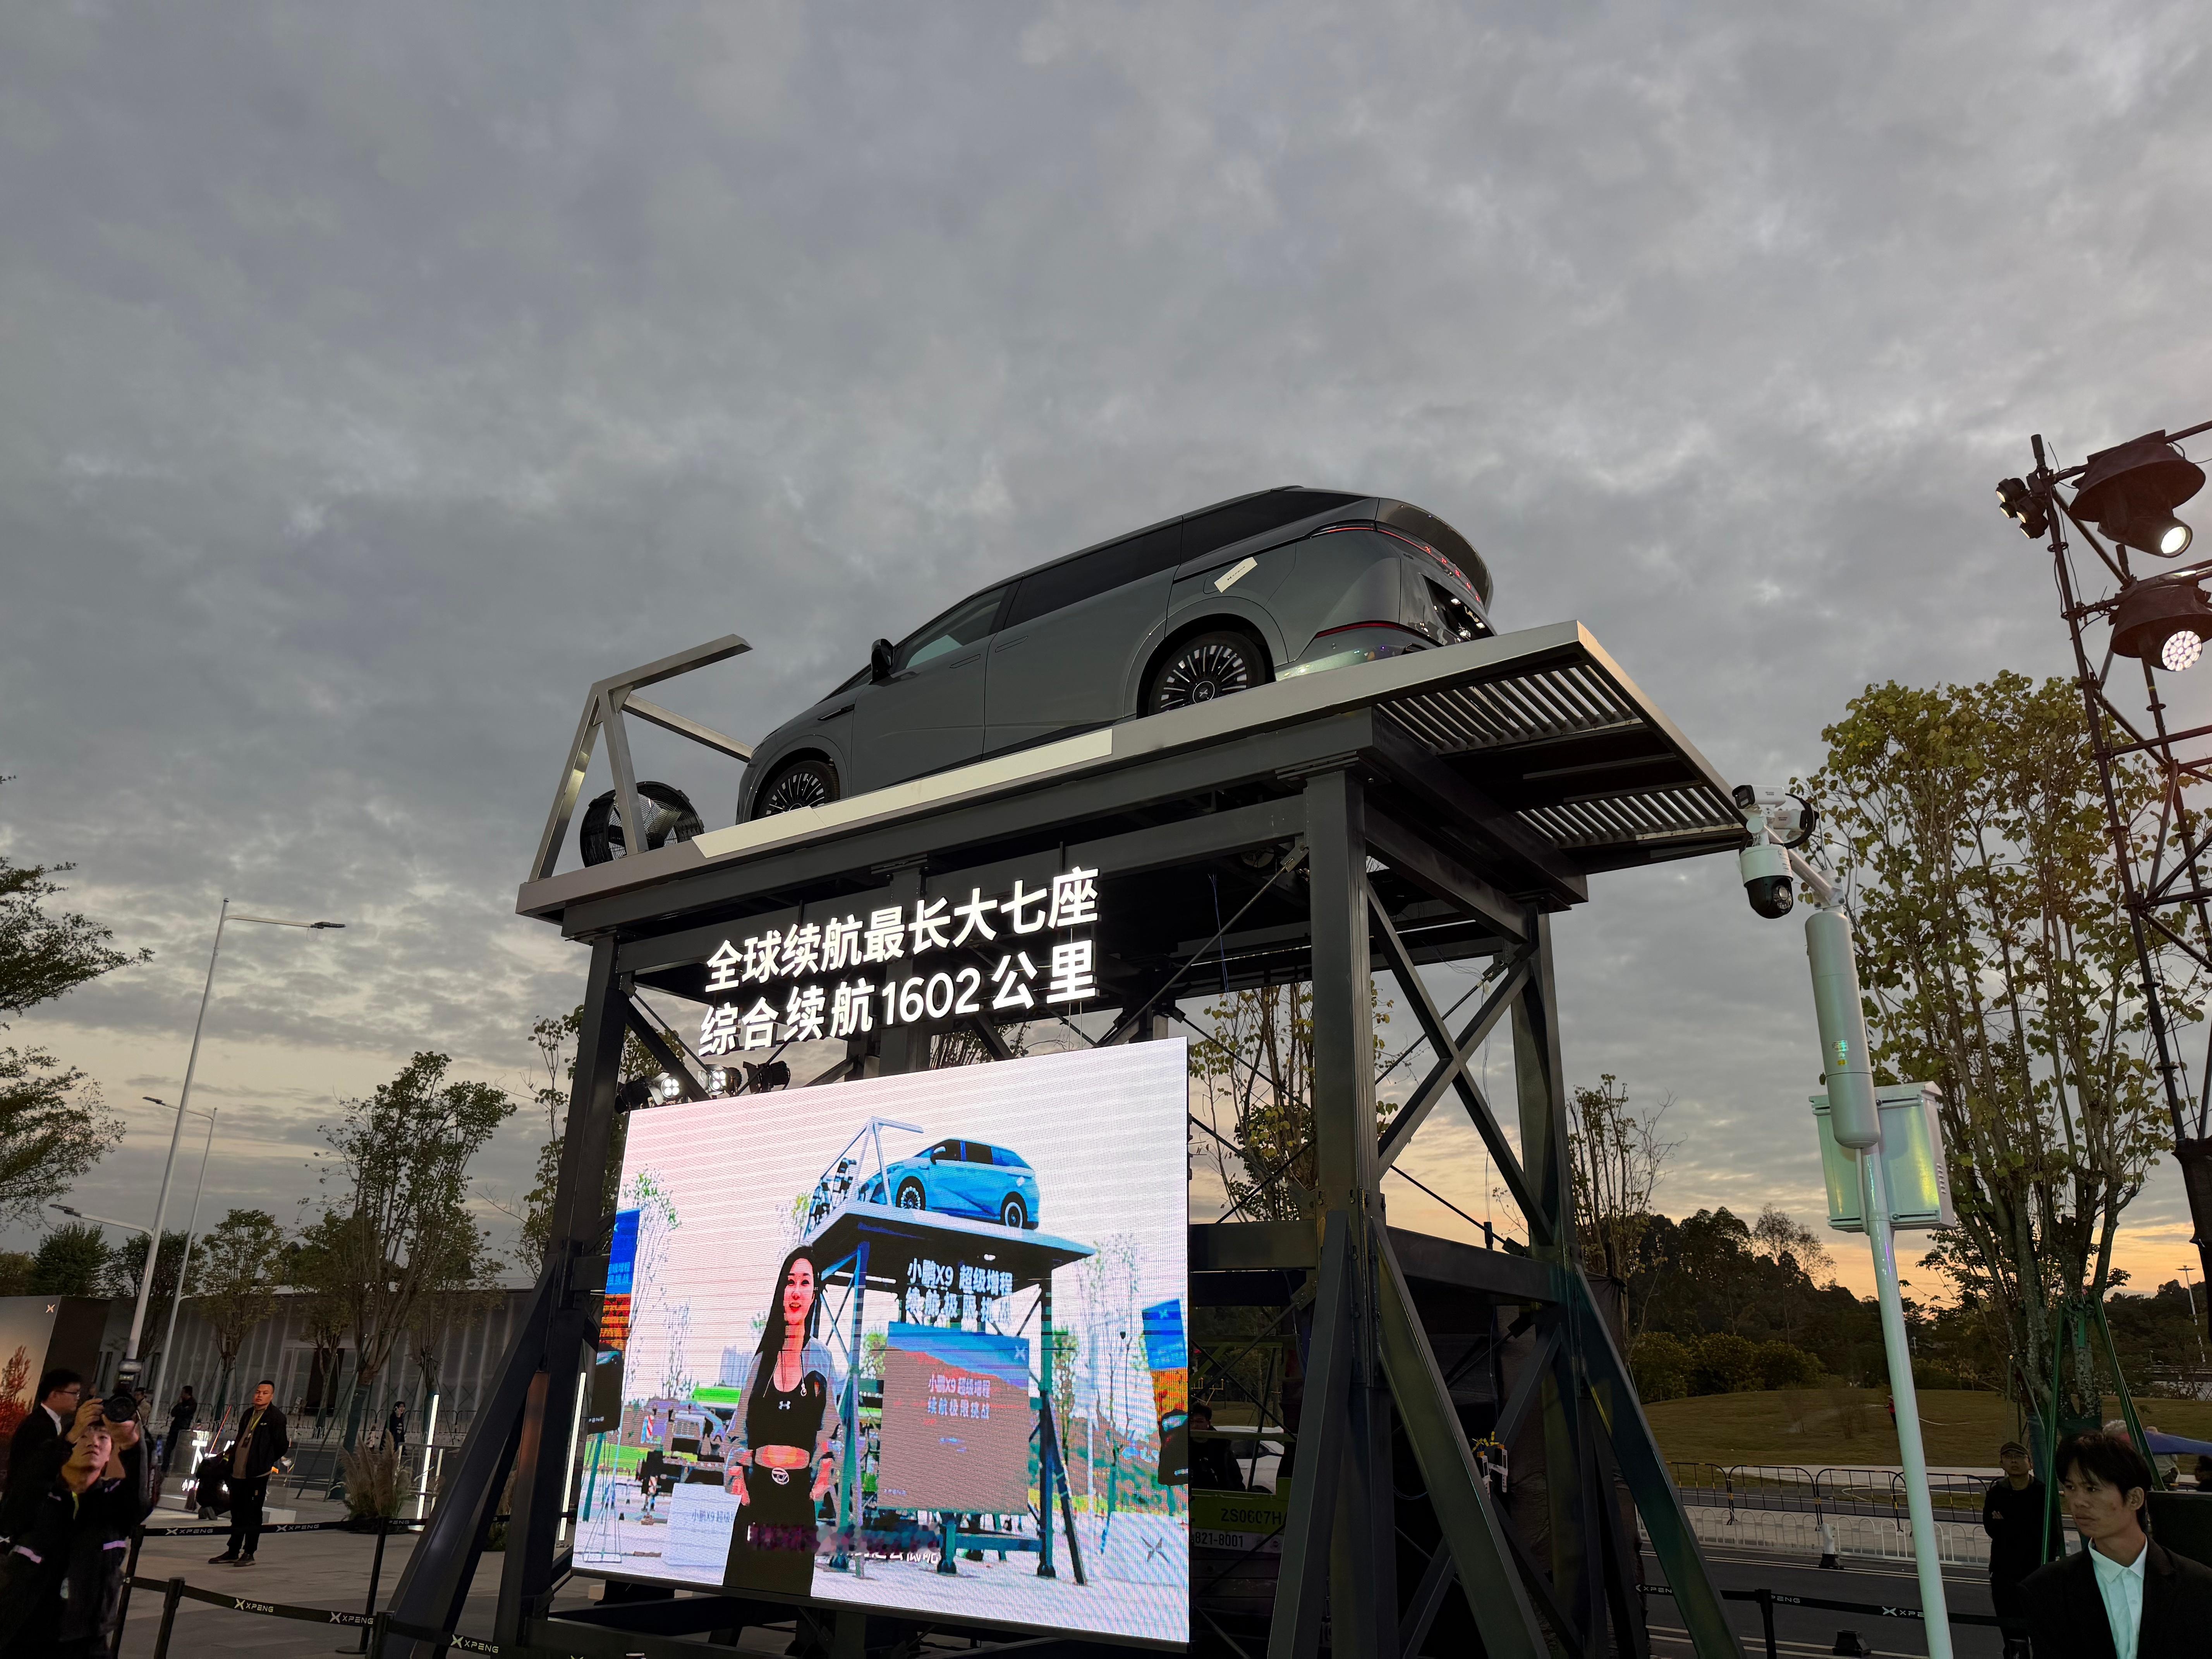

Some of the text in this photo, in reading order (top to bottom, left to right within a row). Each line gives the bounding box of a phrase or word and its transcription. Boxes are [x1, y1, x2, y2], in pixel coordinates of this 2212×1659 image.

[704, 866, 1100, 994] 全球续航最长大七座
[698, 939, 1099, 1056] 综合续航1602公里
[1221, 1508, 1288, 1525] ZS0607H
[1192, 1532, 1243, 1547] 821-8001
[1771, 1595, 1800, 1603] PENG
[246, 1602, 274, 1613] XPENG
[1899, 1609, 1924, 1618] XPE
[342, 1615, 374, 1625] XPENG
[464, 1639, 499, 1654] XPENG
